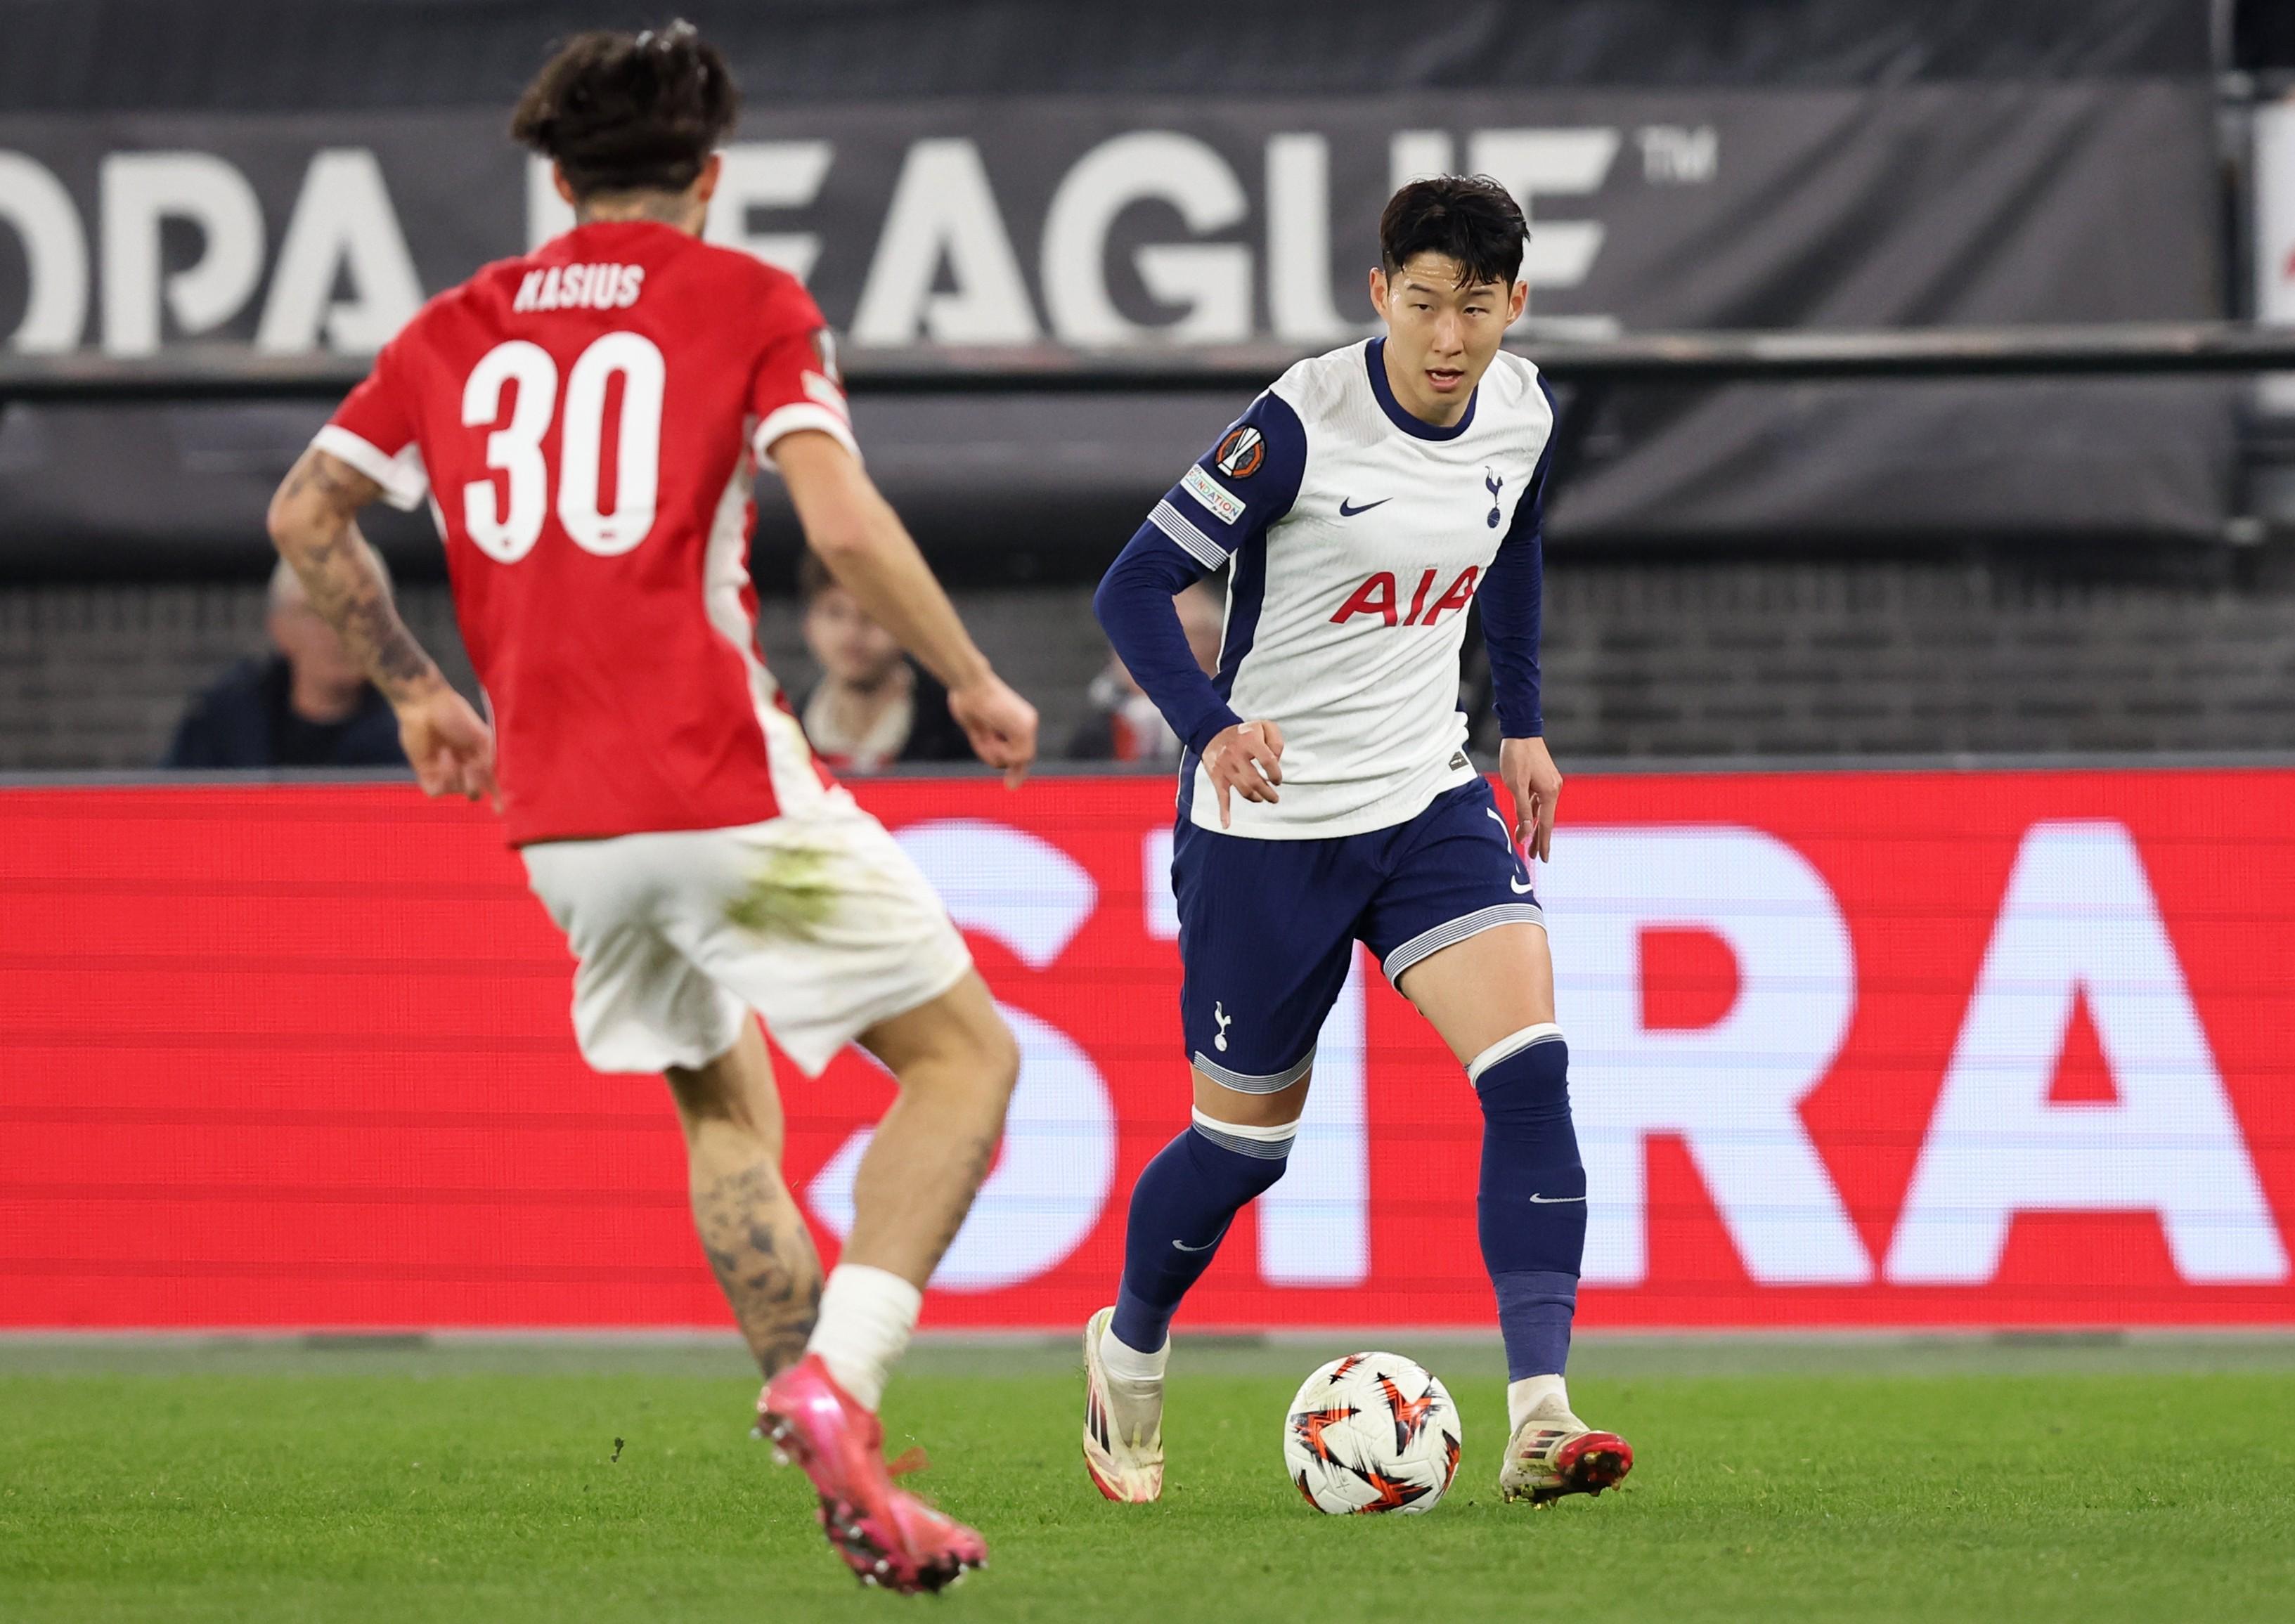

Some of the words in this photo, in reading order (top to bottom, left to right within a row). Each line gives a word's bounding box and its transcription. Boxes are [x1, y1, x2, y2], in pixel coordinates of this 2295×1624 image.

[526, 129, 1621, 349] EAGUE
[512, 263, 645, 313] KASIUS
[461, 330, 666, 565] 30
[1188, 470, 1240, 517] FOUNDATION
[1328, 565, 1479, 627] AIA
